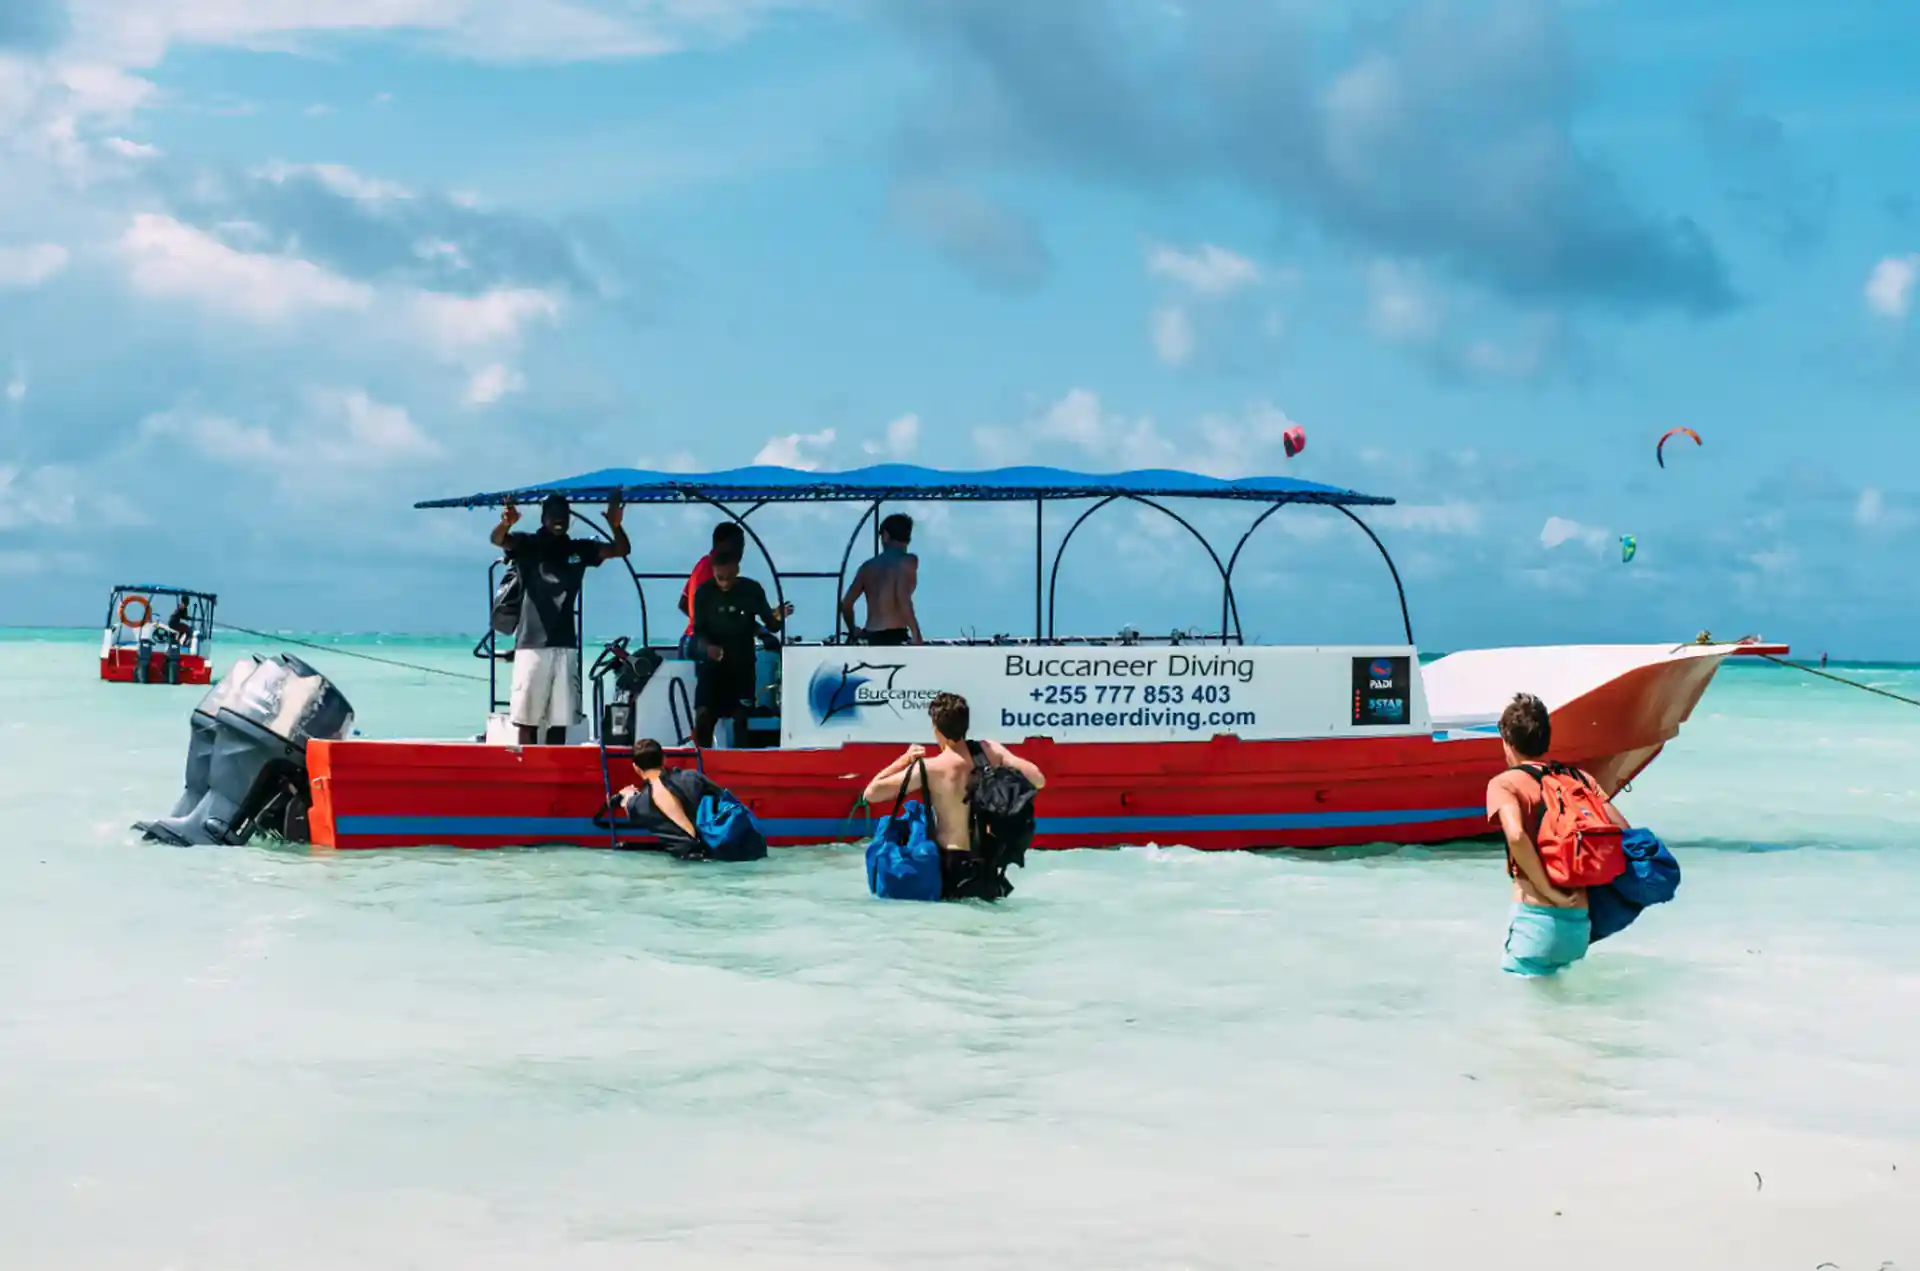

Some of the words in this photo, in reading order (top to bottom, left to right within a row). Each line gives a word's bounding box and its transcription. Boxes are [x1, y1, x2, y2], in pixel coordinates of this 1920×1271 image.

[1005, 654, 1157, 677] Buccaneer
[1168, 654, 1254, 683] Diving
[1369, 679, 1393, 689] PADI
[1029, 685, 1087, 704] +255
[1095, 685, 1136, 704] 777
[1143, 685, 1184, 704] 853
[1191, 685, 1231, 704] 403
[1001, 708, 1256, 730] buccaneerdiving.com
